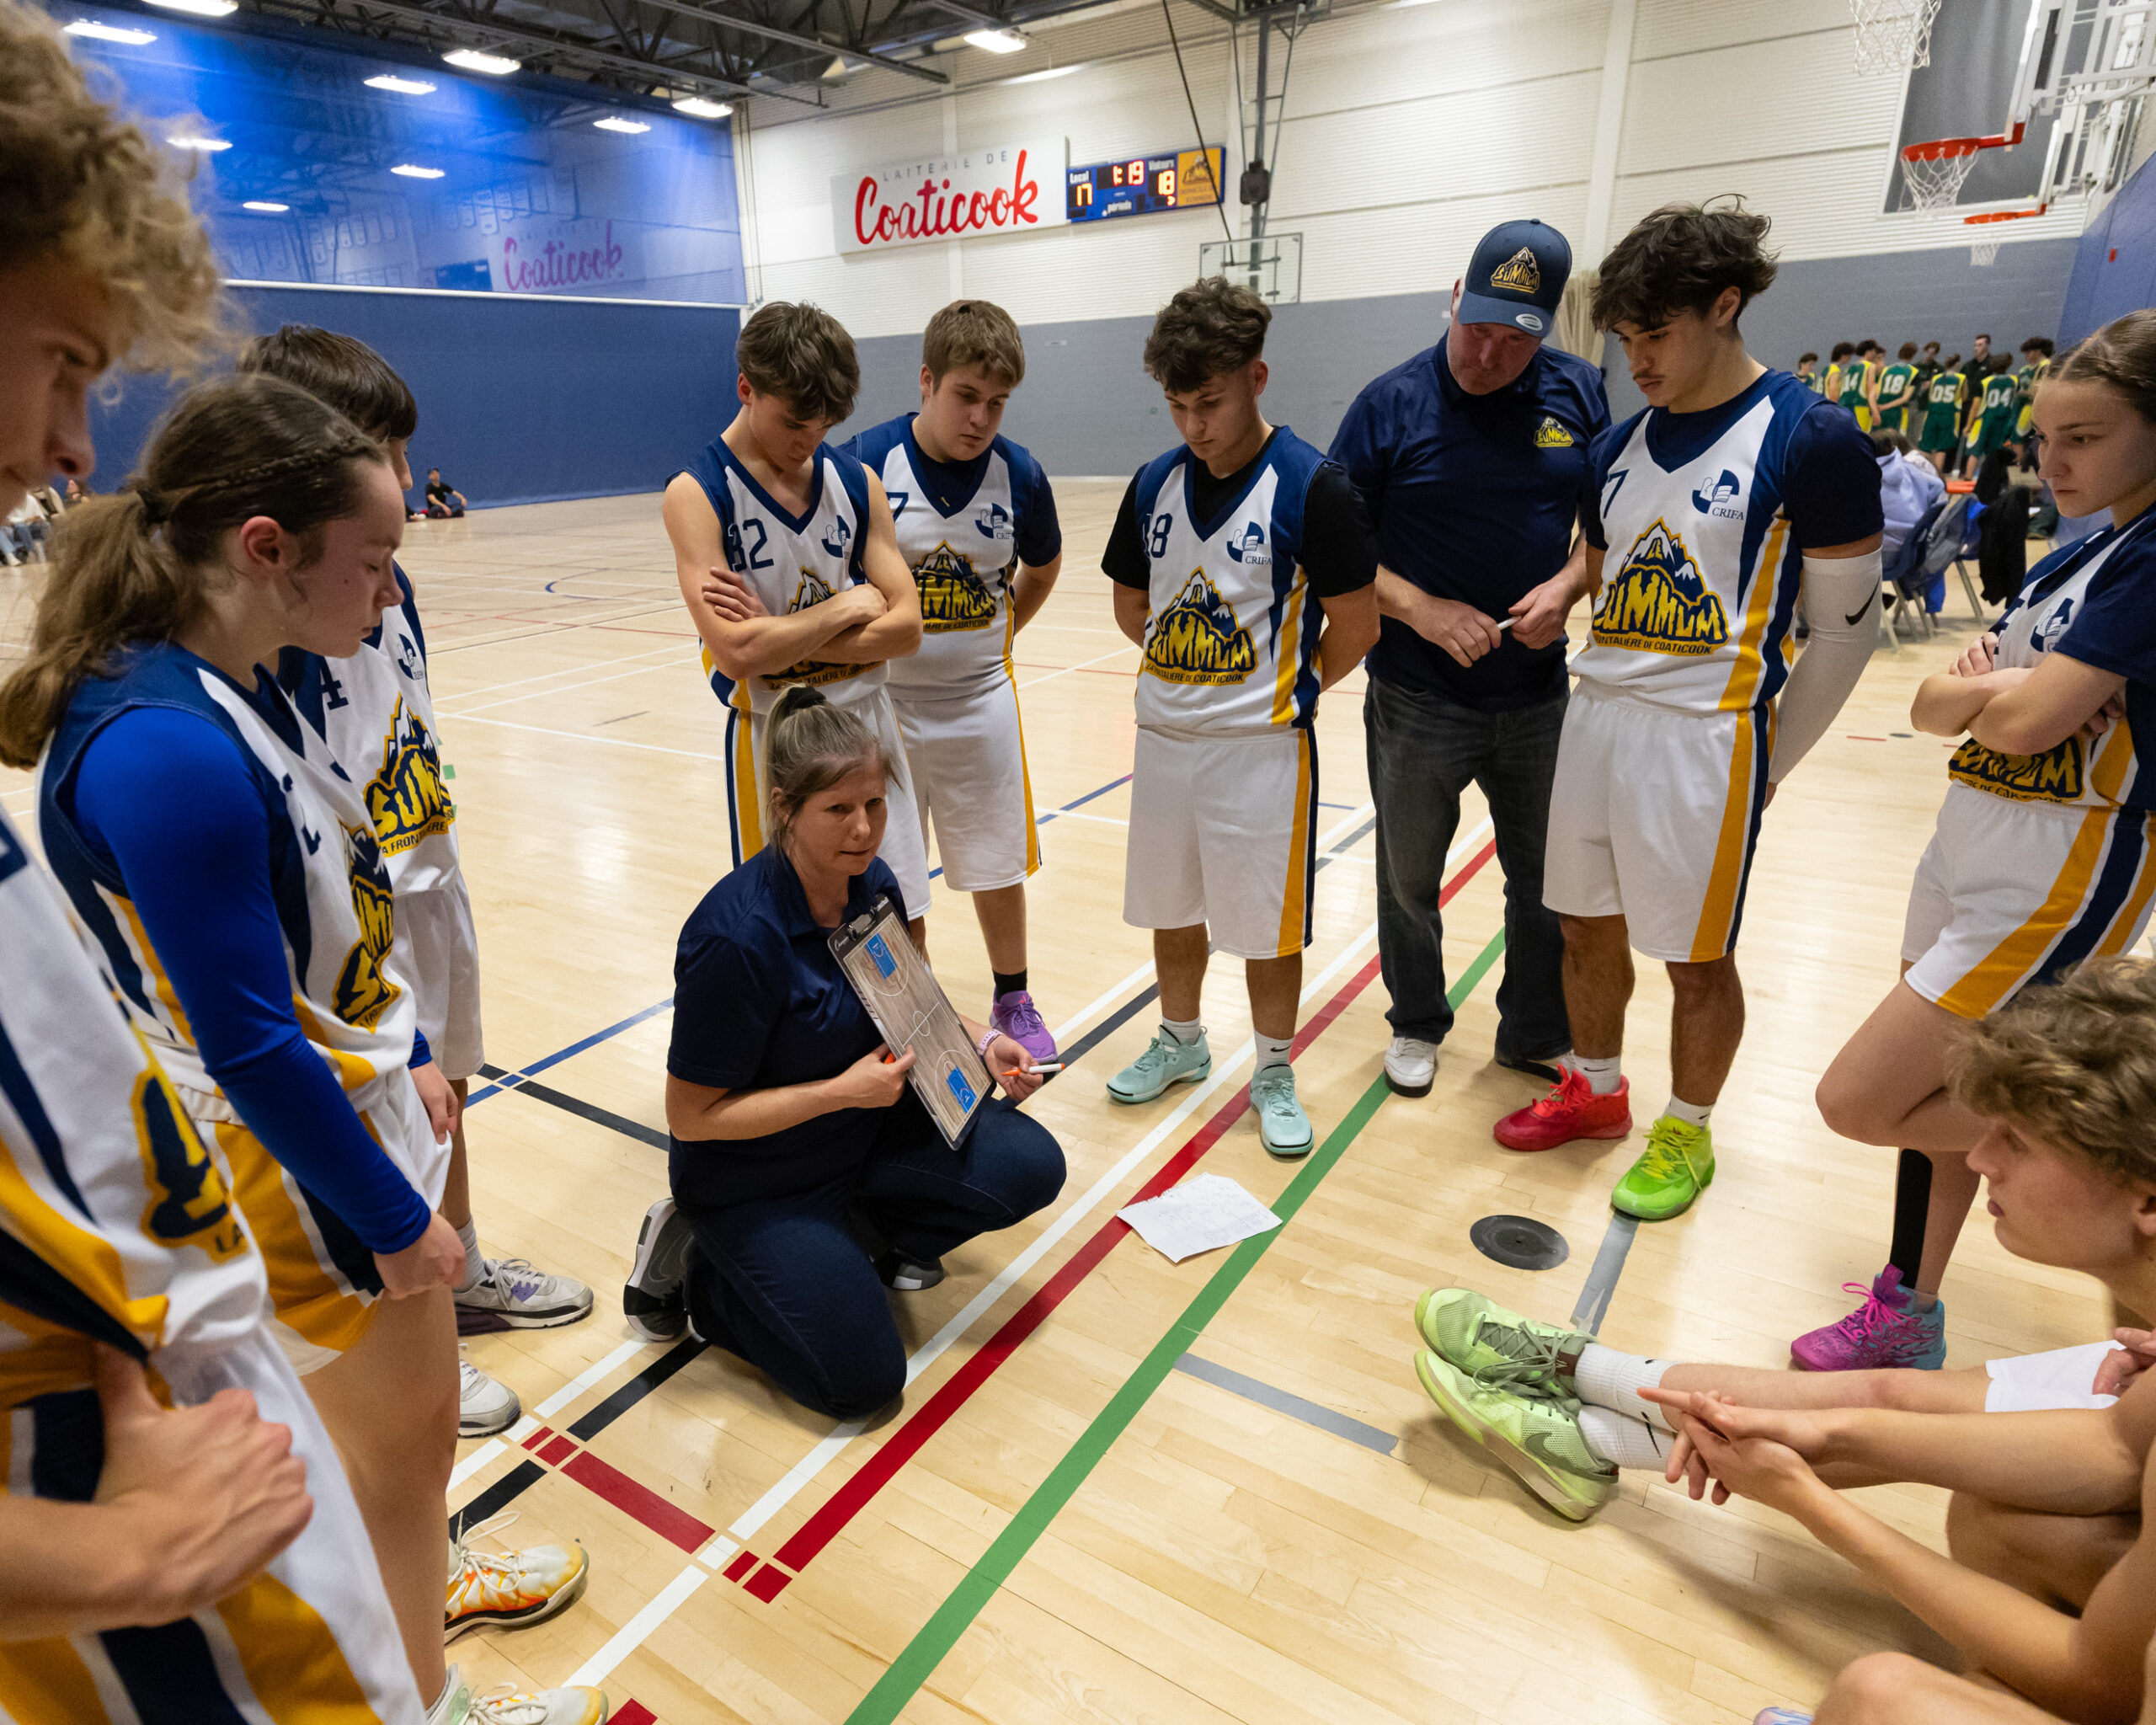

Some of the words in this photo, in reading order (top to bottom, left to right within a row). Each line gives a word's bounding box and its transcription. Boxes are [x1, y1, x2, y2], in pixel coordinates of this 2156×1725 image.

[986, 151, 1007, 165] DE
[1158, 170, 1176, 195] 18
[855, 149, 1038, 244] Coaticook
[1076, 183, 1093, 207] 17
[504, 220, 622, 291] Coaticook
[1882, 374, 1905, 394] 18
[1931, 385, 1956, 403] 05
[1987, 387, 2013, 409] 04
[1711, 506, 1745, 521] CRIFA
[1245, 555, 1273, 565] CRIFA
[1643, 641, 1652, 649] DE
[1654, 641, 1712, 654] COATICOOK
[1193, 673, 1244, 683] COATICOOK
